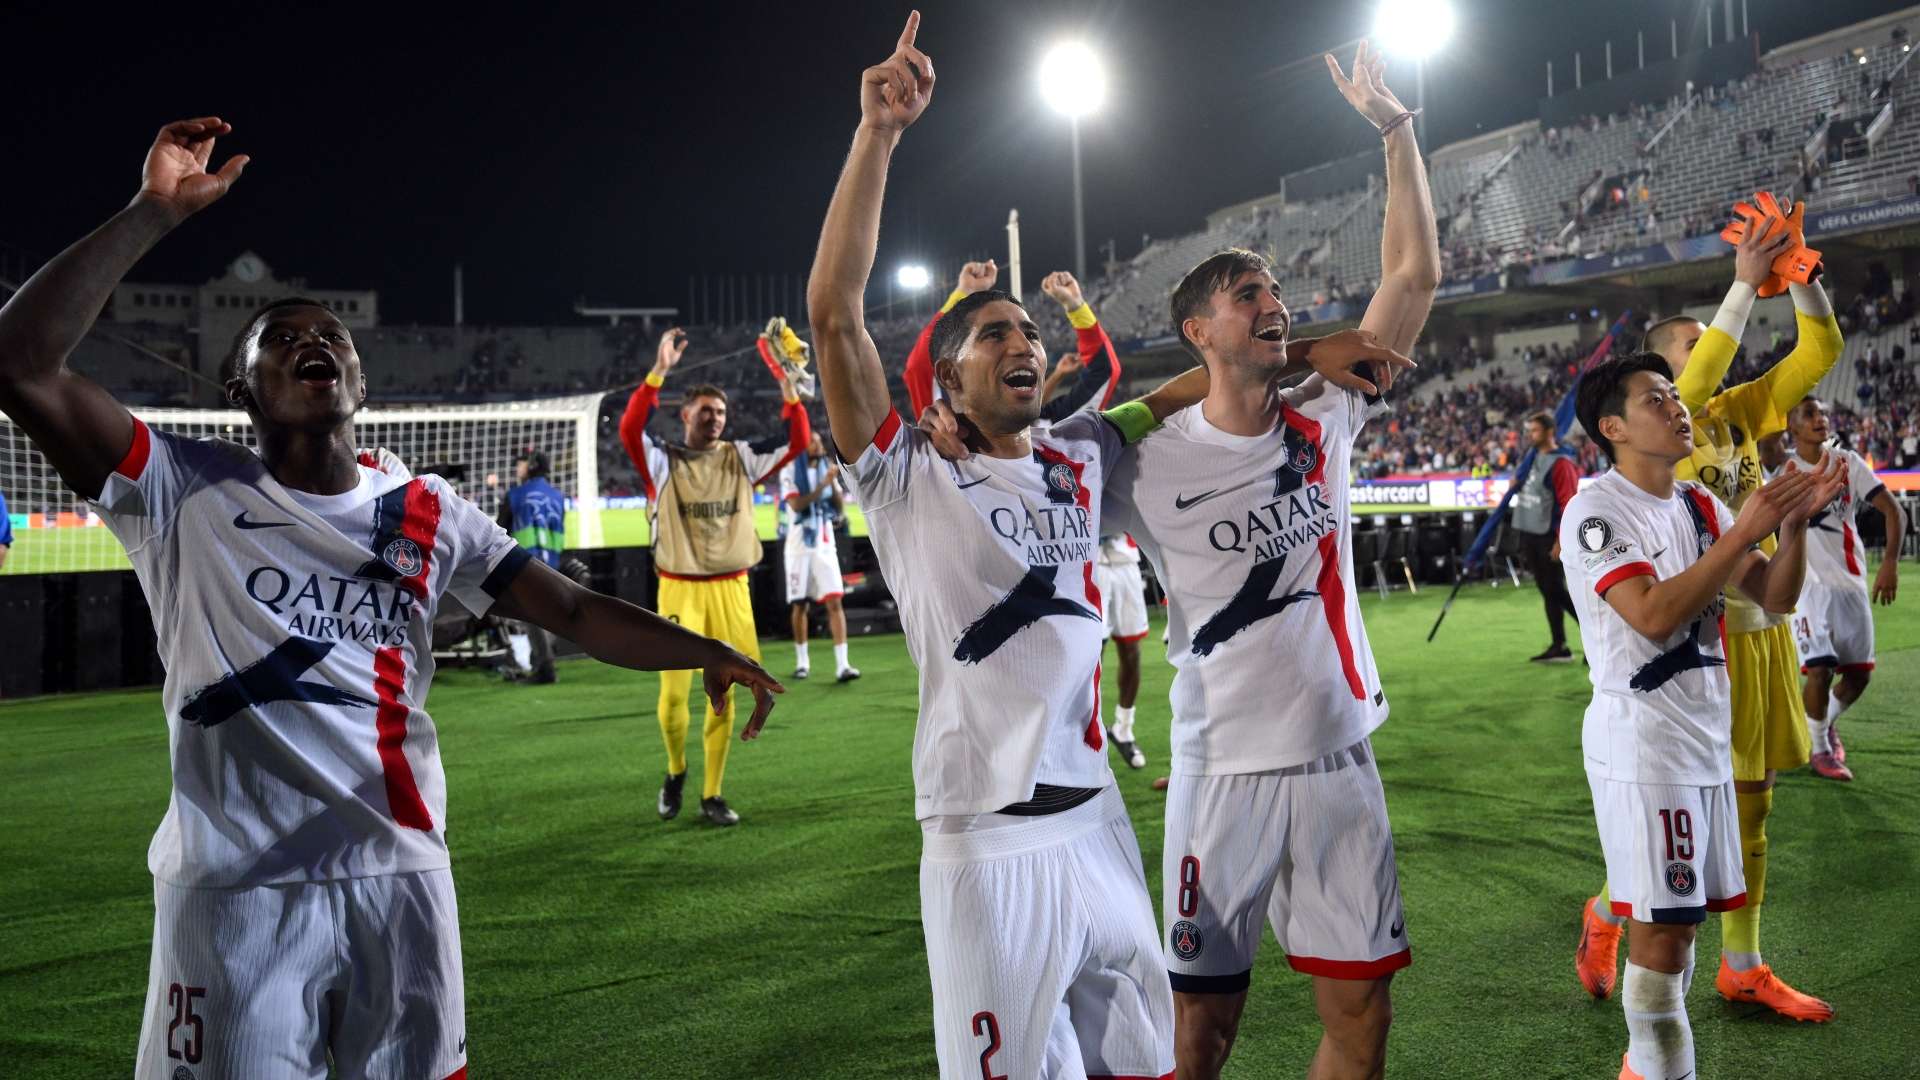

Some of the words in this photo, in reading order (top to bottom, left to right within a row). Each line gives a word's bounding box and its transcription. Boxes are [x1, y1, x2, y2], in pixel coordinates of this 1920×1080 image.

[1818, 214, 1848, 230] UEFA
[1209, 485, 1330, 554] QATAR
[1350, 483, 1427, 504] astercard
[389, 541, 415, 551] PARIS
[991, 494, 1090, 546] QATAR
[1255, 513, 1337, 563] AIRWAYS
[246, 566, 415, 622] QATAR
[288, 613, 407, 646] AIRWAYS
[1795, 617, 1810, 640] 24
[1659, 808, 1695, 861] 19
[1179, 855, 1200, 917] 8
[168, 983, 207, 1064] 25
[972, 1011, 1008, 1080] 2
